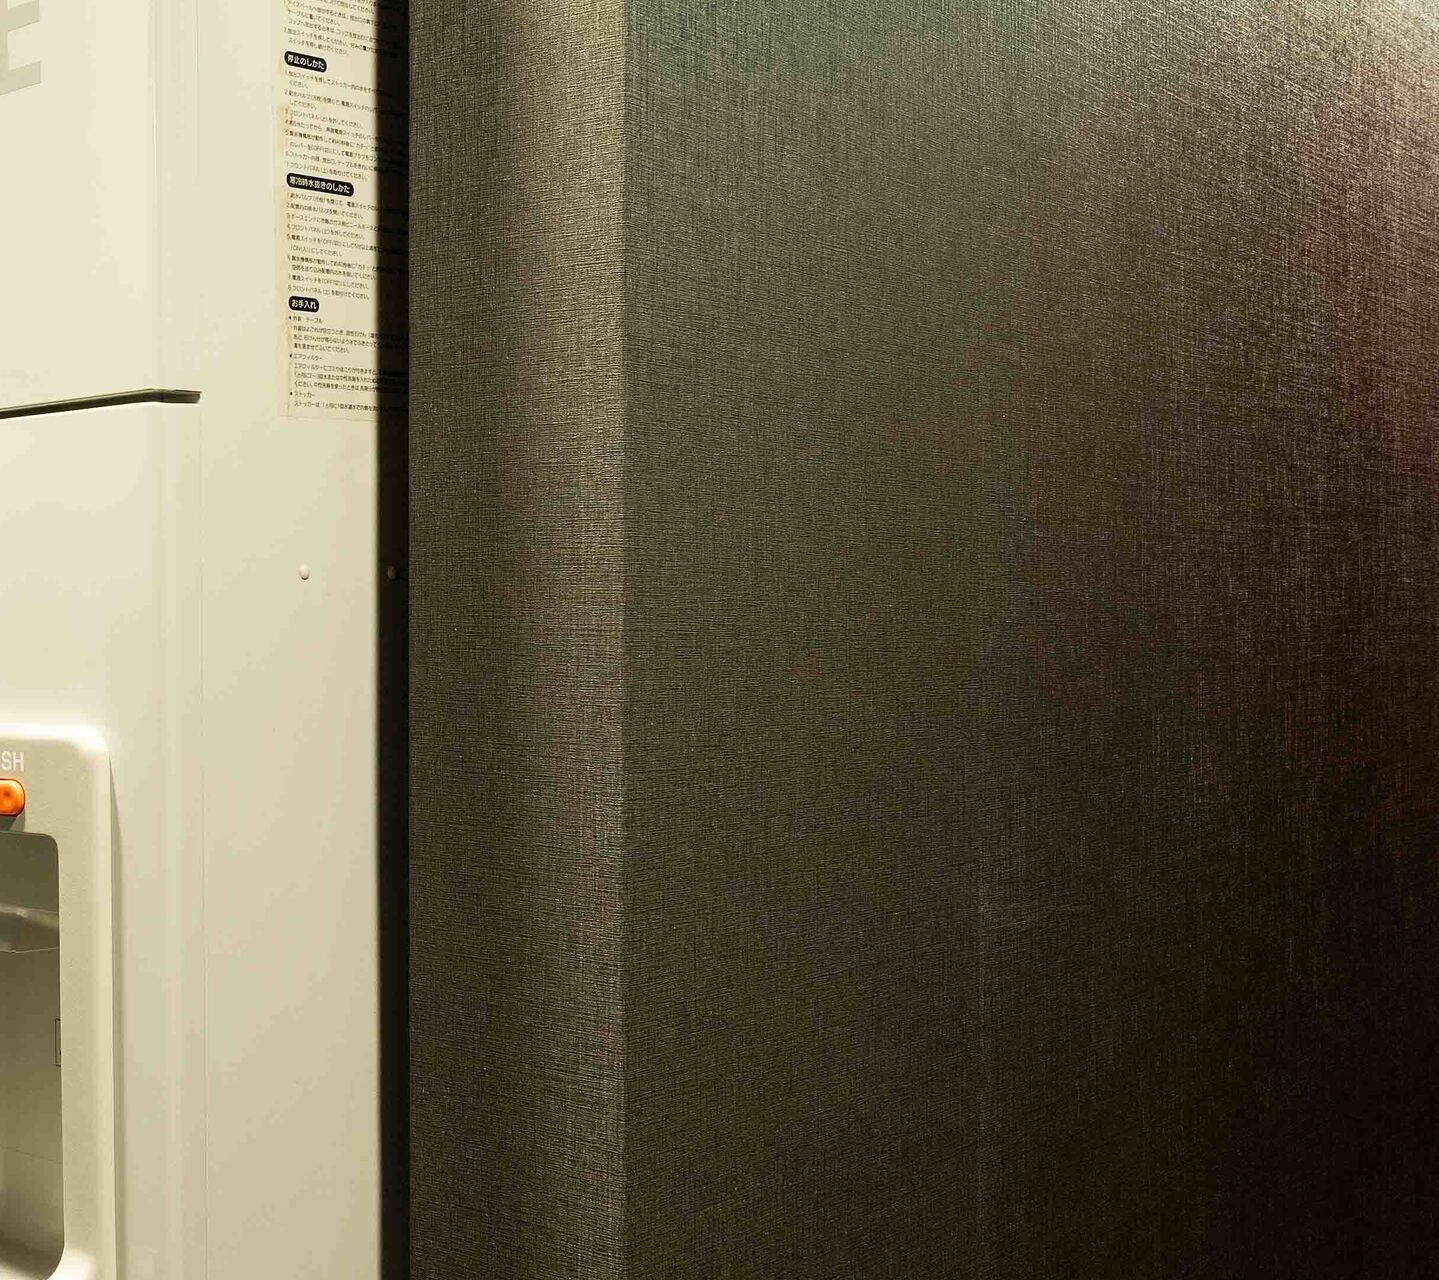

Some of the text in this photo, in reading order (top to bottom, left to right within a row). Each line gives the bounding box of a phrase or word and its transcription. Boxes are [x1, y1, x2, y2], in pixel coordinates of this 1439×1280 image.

[287, 53, 326, 71] 停止のしかた
[288, 175, 351, 195] 寒冷時水抜きのしかた
[291, 298, 317, 311] お手入れ
